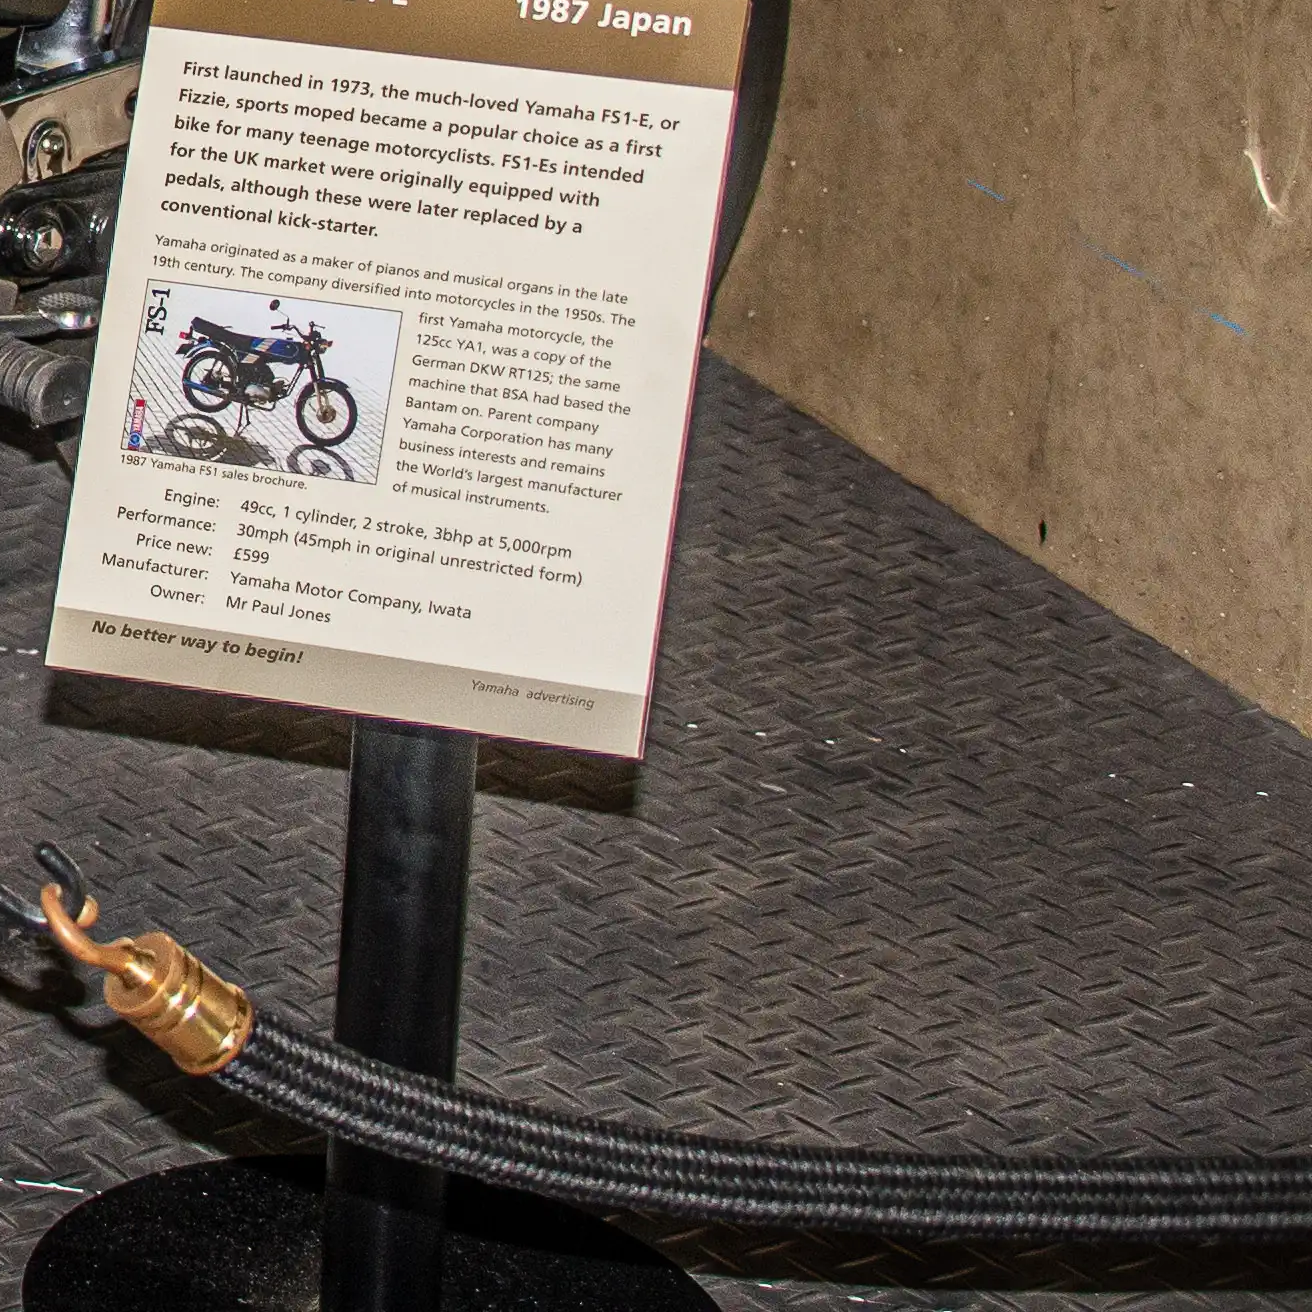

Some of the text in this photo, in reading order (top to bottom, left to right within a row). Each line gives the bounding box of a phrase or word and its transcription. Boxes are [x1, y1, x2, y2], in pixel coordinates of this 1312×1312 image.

[596, 2, 692, 37] Japan
[182, 60, 681, 131] First launched in 1973, the much-loved Yamaha FS1-E, or
[177, 87, 663, 158] Fizzie, sports moped became popular choice as first
[173, 113, 645, 184] bike for many teenage motorcyclists. FS1-Es intended
[169, 140, 600, 208] for the UK market were originally equipped with
[159, 199, 378, 238] conventional kick-starter.
[163, 171, 568, 236] pedals, although these were later replaced by
[152, 254, 636, 328] 19th century. The company diversified into motorcycles the 1950s. The
[154, 233, 629, 305] Yamaha originated maker pianos and musical organs the late
[144, 288, 171, 335] FS-1
[418, 311, 614, 349] first Yamaha motorcycle, the
[411, 353, 466, 373] German
[469, 361, 506, 377] DKW
[557, 372, 582, 387] the
[584, 378, 621, 393] same
[416, 332, 612, 370] 125cc YA1, was copy the
[404, 395, 600, 436] Bantam on. Parent company
[407, 376, 632, 416] machine that BSA had based the
[398, 436, 606, 478] business interests and remains
[402, 416, 614, 460] Yamaha Corporation has many
[120, 453, 308, 490] 1987 Yamaha FS1 sales brochure.
[395, 458, 419, 474] the
[476, 469, 524, 489] largest
[526, 479, 623, 502] manufacturer
[410, 485, 550, 514] musical instruments.
[163, 487, 572, 560] Engine: 49cc, cylinder, stroke, 3bhp at 5,000rpm
[116, 505, 583, 588] Performance: 30mph (45mph in original unrestricted form)
[135, 532, 270, 565] Price new: £599
[101, 551, 472, 620] Manufacturer: Yamaha Motor Company, Iwata
[149, 583, 331, 623] Owner: Mr Paul Jones
[90, 619, 304, 664] No better way to begin!
[471, 678, 596, 711] Yamaha advertising
